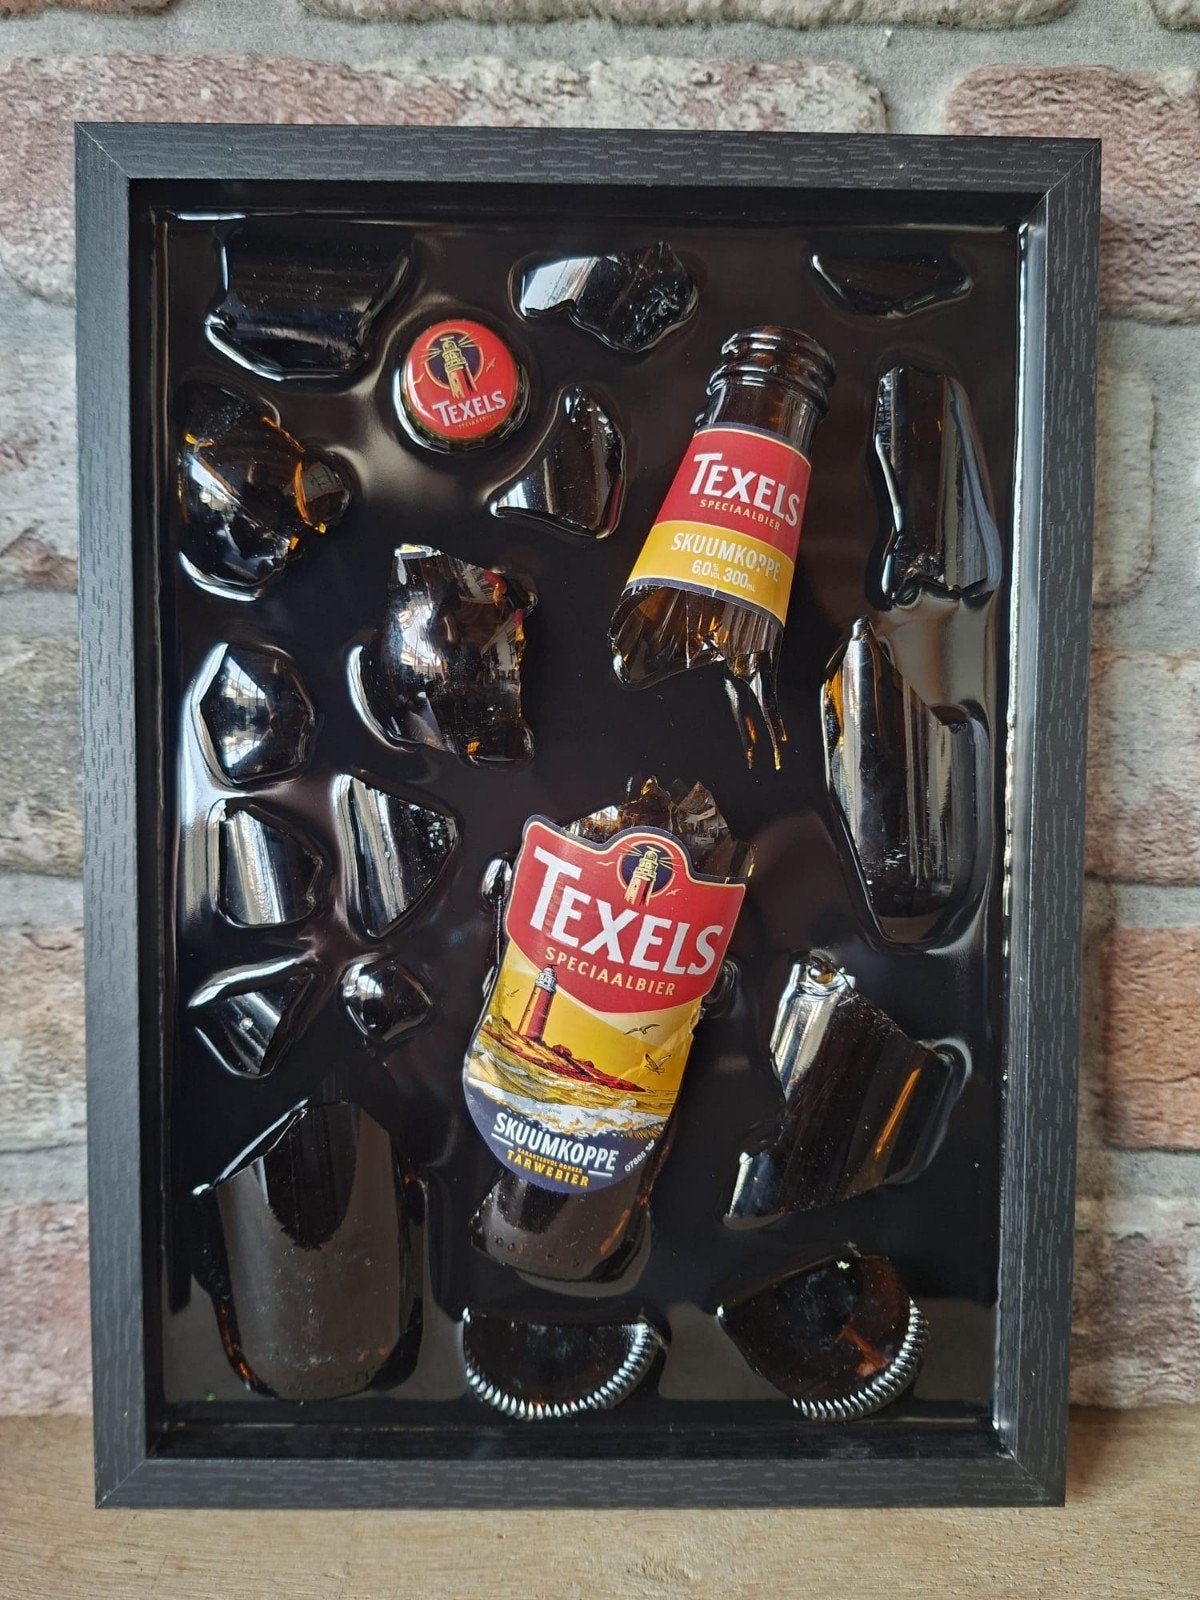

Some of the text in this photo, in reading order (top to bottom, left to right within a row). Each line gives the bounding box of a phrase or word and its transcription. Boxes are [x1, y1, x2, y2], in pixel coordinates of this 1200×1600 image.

[432, 390, 506, 427] TEXELS
[689, 452, 801, 527] TEXELS
[700, 499, 781, 531] SPECIAALBIER
[671, 532, 781, 582] SKUUMKOPPE
[529, 846, 724, 976] TEXELS
[545, 946, 676, 997] SPECIAALBIER
[493, 1112, 620, 1171] SKUUMKOPPE
[506, 1149, 590, 1187] TARWEBIER
